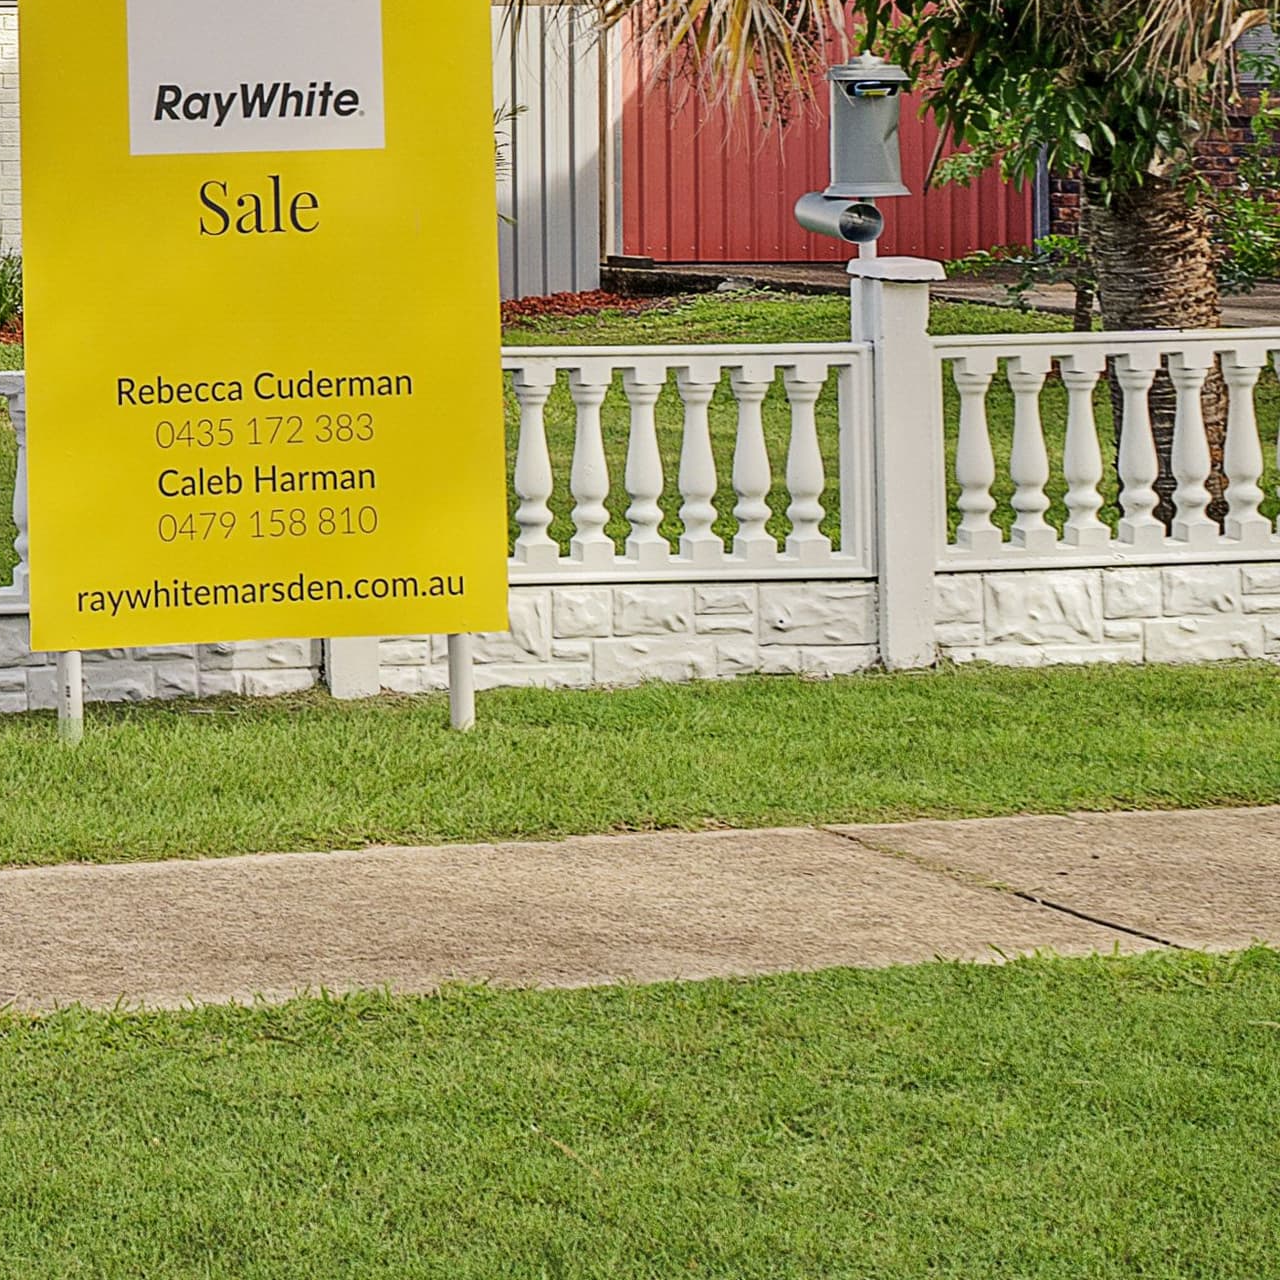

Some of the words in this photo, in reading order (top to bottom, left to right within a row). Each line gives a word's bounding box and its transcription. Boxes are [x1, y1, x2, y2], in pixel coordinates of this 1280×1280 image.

[199, 175, 320, 236] Sale
[117, 375, 243, 406] Rebecca
[253, 370, 413, 401] Cuderman
[156, 418, 234, 448] 0435
[247, 415, 304, 445] 172
[315, 413, 374, 442] 383
[158, 466, 243, 497] Caleb
[255, 465, 376, 493] Harman
[159, 512, 236, 542] 0479
[250, 508, 307, 538] 158
[319, 505, 377, 535] 810
[77, 572, 464, 616] raywhitemarsden.com.au
